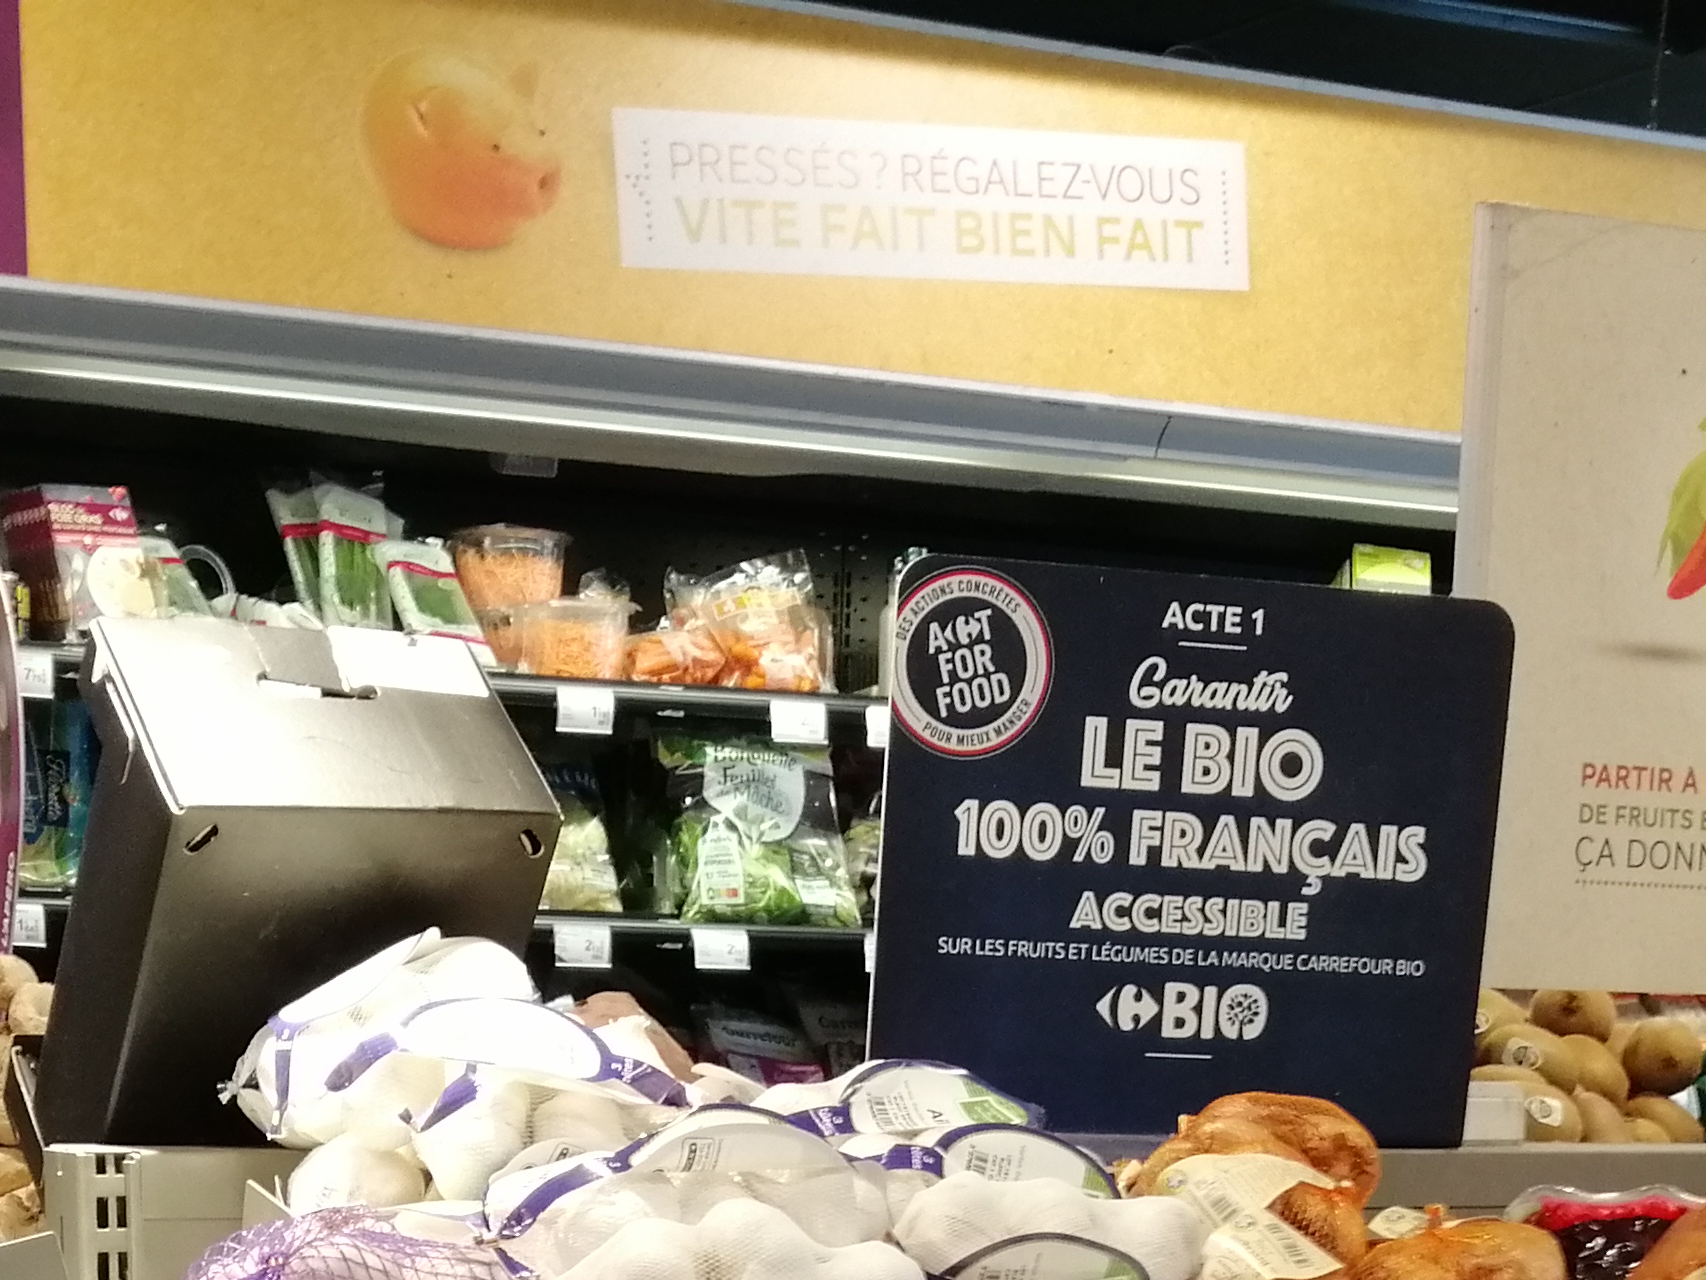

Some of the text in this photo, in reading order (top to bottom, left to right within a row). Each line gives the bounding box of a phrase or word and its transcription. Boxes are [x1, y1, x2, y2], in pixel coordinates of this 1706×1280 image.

[674, 198, 1204, 264] VITE FAIT BIEN FAIT
[896, 616, 913, 642] DES
[909, 582, 955, 621] ACTIONS
[1161, 602, 1266, 636] ACTE 1
[937, 643, 996, 684] FOR
[1128, 655, 1294, 714] Garantir
[935, 672, 1012, 718] FOOD
[922, 698, 1033, 747] POUR MIEUX MANGER
[1079, 714, 1325, 802] LE BIO
[1580, 762, 1673, 793] PARTIR
[1682, 763, 1699, 796] À
[1578, 803, 1607, 826] DE
[1614, 805, 1694, 831] FRUITS
[954, 797, 1430, 897] 100% FRANÇAIS
[1574, 836, 1616, 873] ÇA
[1068, 889, 1309, 941] ACCESSIBLE
[938, 935, 1426, 977] SUR LES FRUITS ET LÉGUMES DE LA MARQUE CARREFOUR BIO
